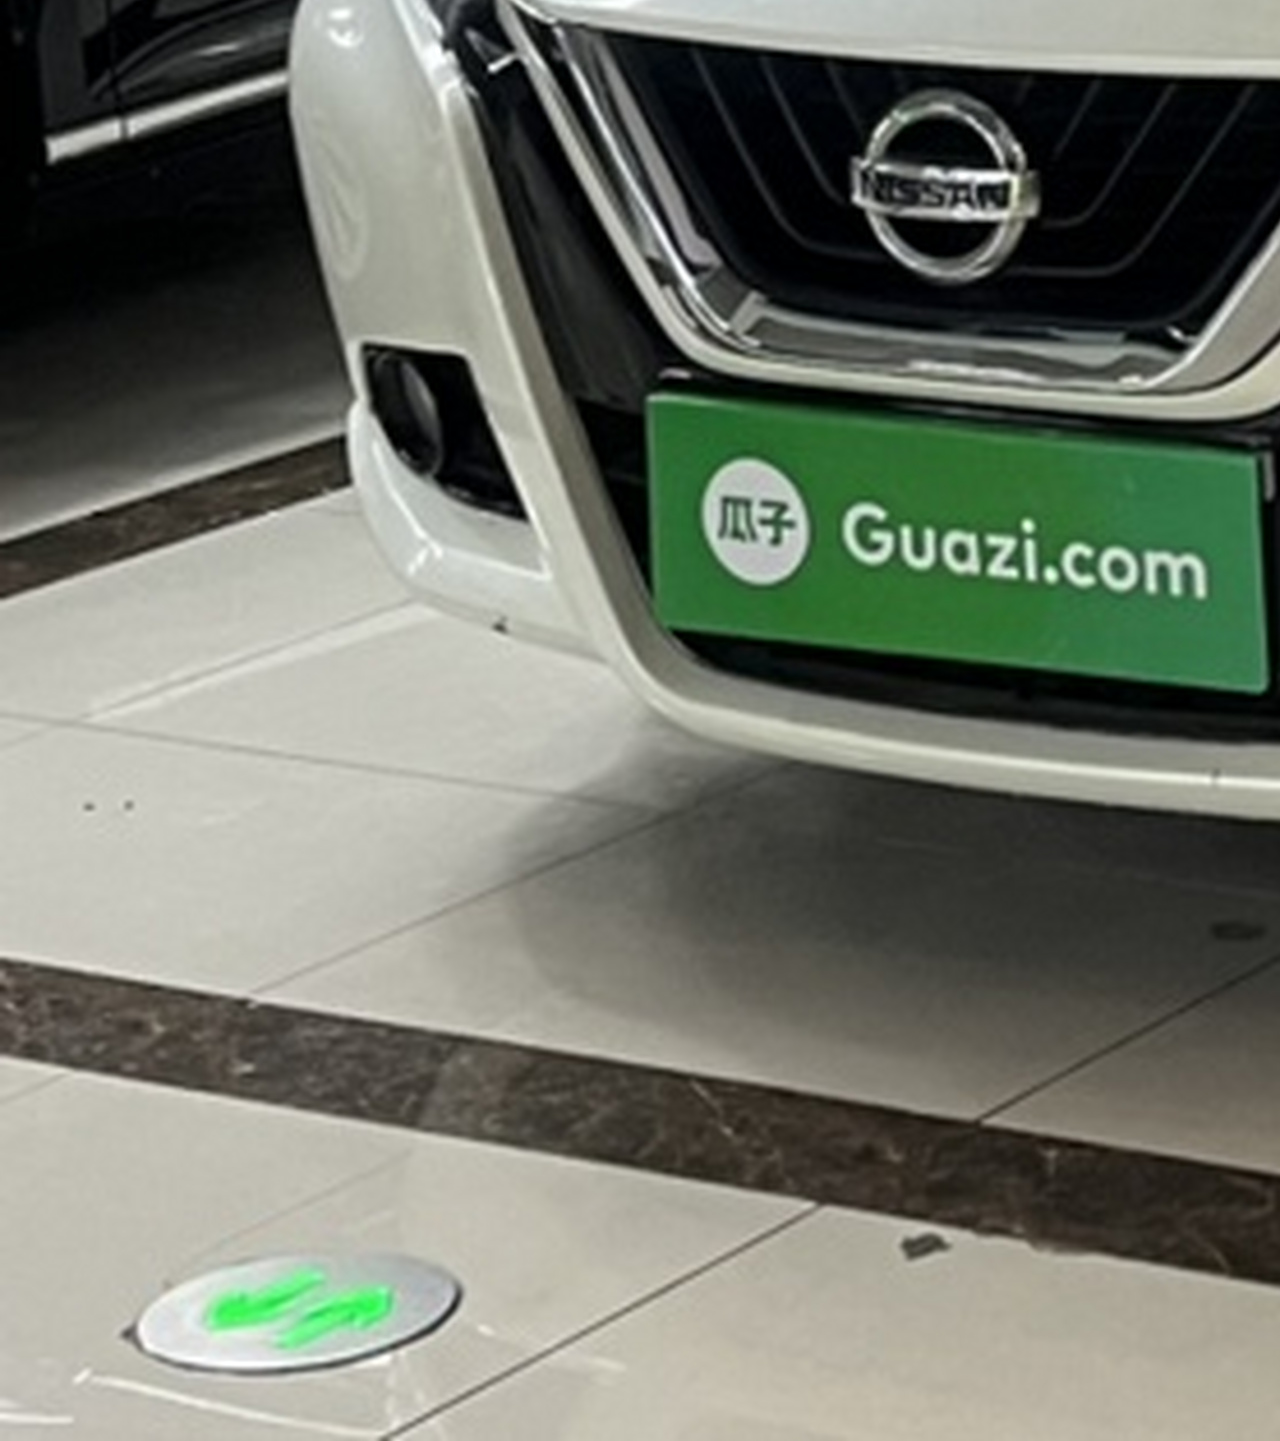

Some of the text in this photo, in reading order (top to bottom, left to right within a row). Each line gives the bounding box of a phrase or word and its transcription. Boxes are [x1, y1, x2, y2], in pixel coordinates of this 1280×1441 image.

[857, 163, 1013, 214] NISSAN
[717, 496, 797, 547] 瓜子
[842, 502, 1207, 600] Guazi.com
